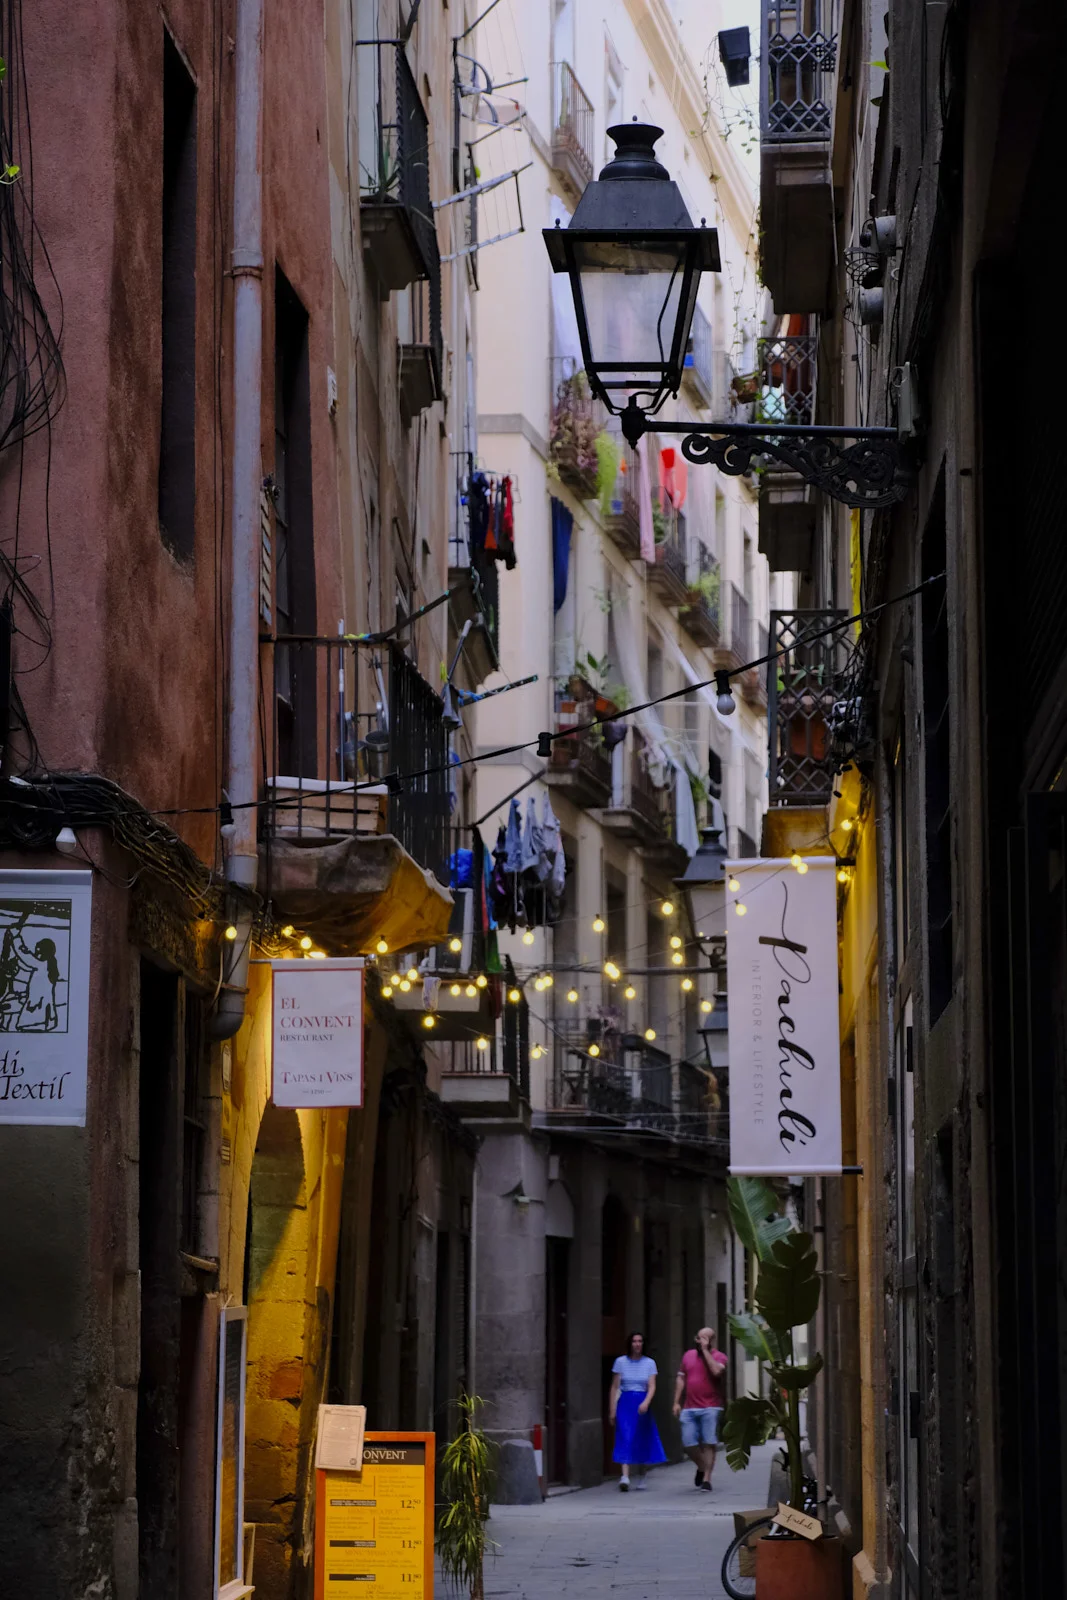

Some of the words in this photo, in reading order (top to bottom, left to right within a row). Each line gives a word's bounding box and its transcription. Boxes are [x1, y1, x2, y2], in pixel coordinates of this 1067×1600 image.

[751, 959, 763, 1028] INTERIOR
[280, 997, 301, 1010] EL
[280, 1015, 355, 1029] CONVENT
[758, 881, 817, 1154] Pachuli
[752, 1034, 763, 1042] &
[280, 1071, 317, 1084] TAPAS
[325, 1071, 354, 1083] VINS
[0, 1071, 72, 1100] Textil
[752, 1050, 764, 1125] LIFESTYLE
[363, 1449, 408, 1460] ONVENT
